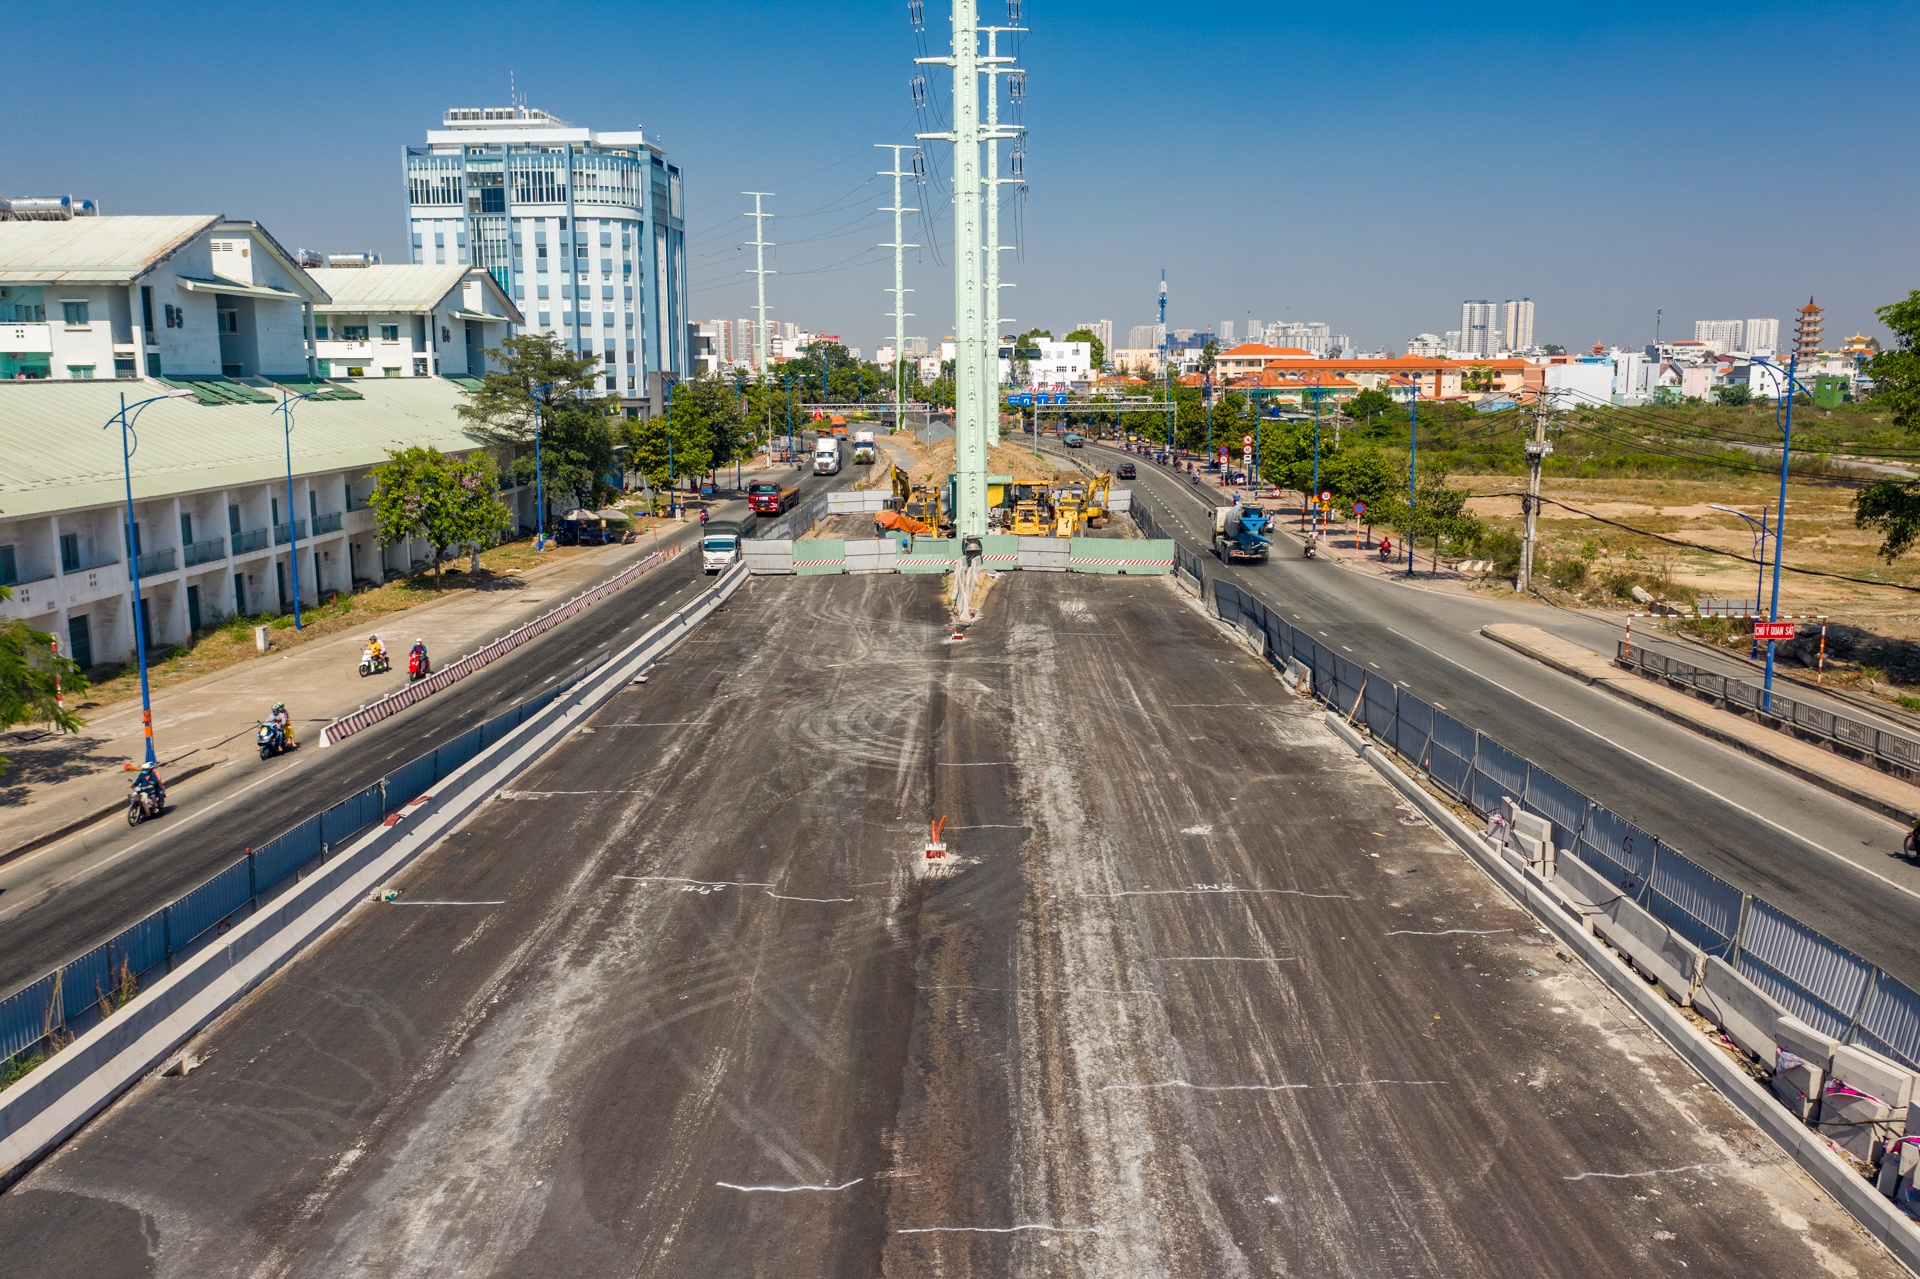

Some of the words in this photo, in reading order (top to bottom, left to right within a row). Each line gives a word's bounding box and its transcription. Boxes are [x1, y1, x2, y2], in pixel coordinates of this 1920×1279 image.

[165, 304, 184, 329] B5
[1770, 626, 1784, 636] QUAN
[1785, 624, 1794, 636] SÁT
